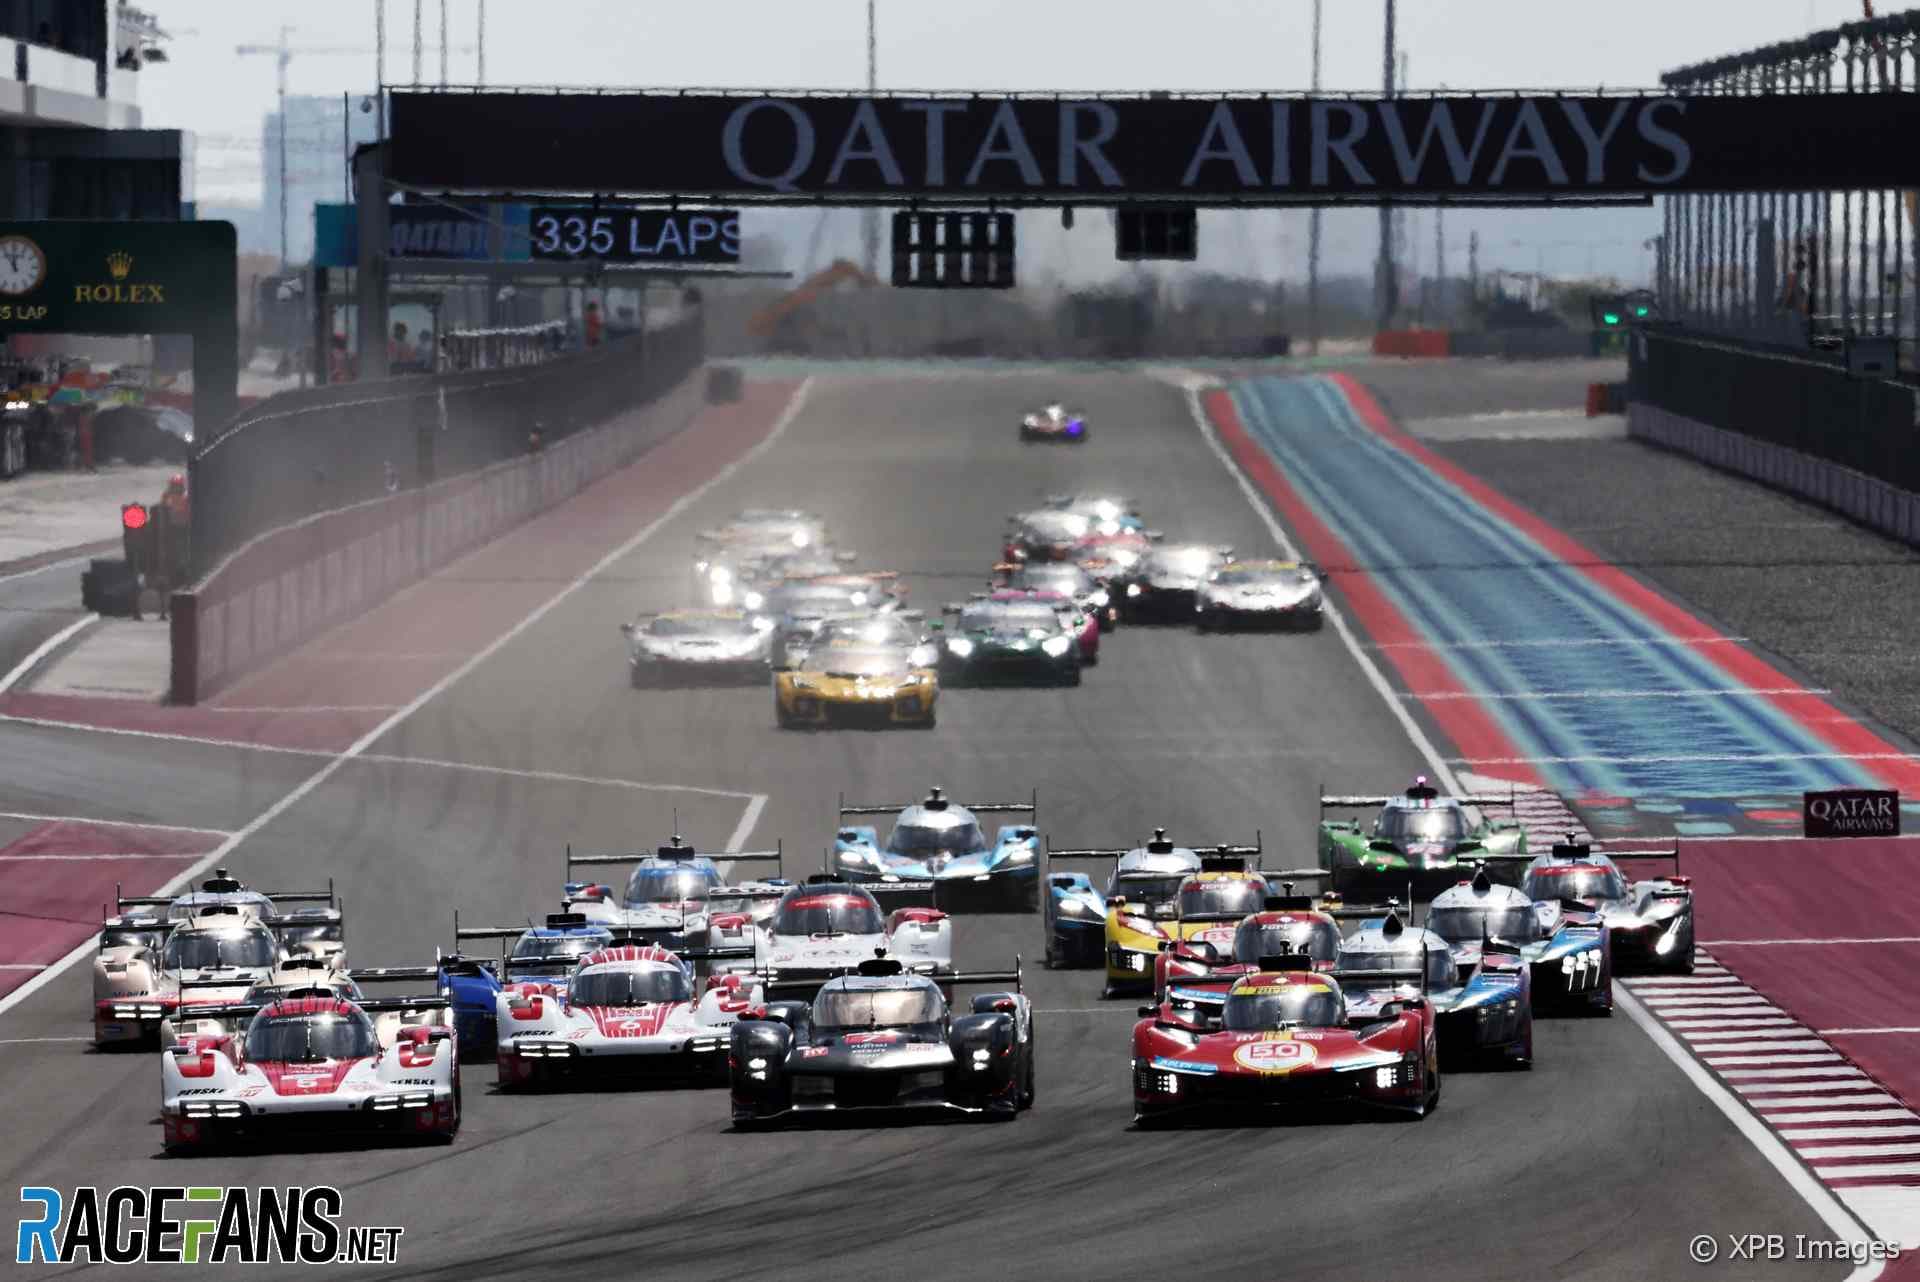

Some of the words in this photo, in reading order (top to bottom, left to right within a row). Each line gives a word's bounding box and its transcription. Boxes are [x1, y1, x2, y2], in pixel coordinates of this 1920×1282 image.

[721, 99, 1124, 192] QATAR
[1181, 99, 1692, 187] AIRWAYS
[536, 216, 614, 253] 335
[630, 217, 739, 255] LAPS
[75, 285, 164, 303] ROLEX
[17, 306, 47, 319] LAP
[1810, 797, 1893, 820] QATAR
[1833, 818, 1894, 830] AIRWAYS
[1251, 1044, 1299, 1057] 50
